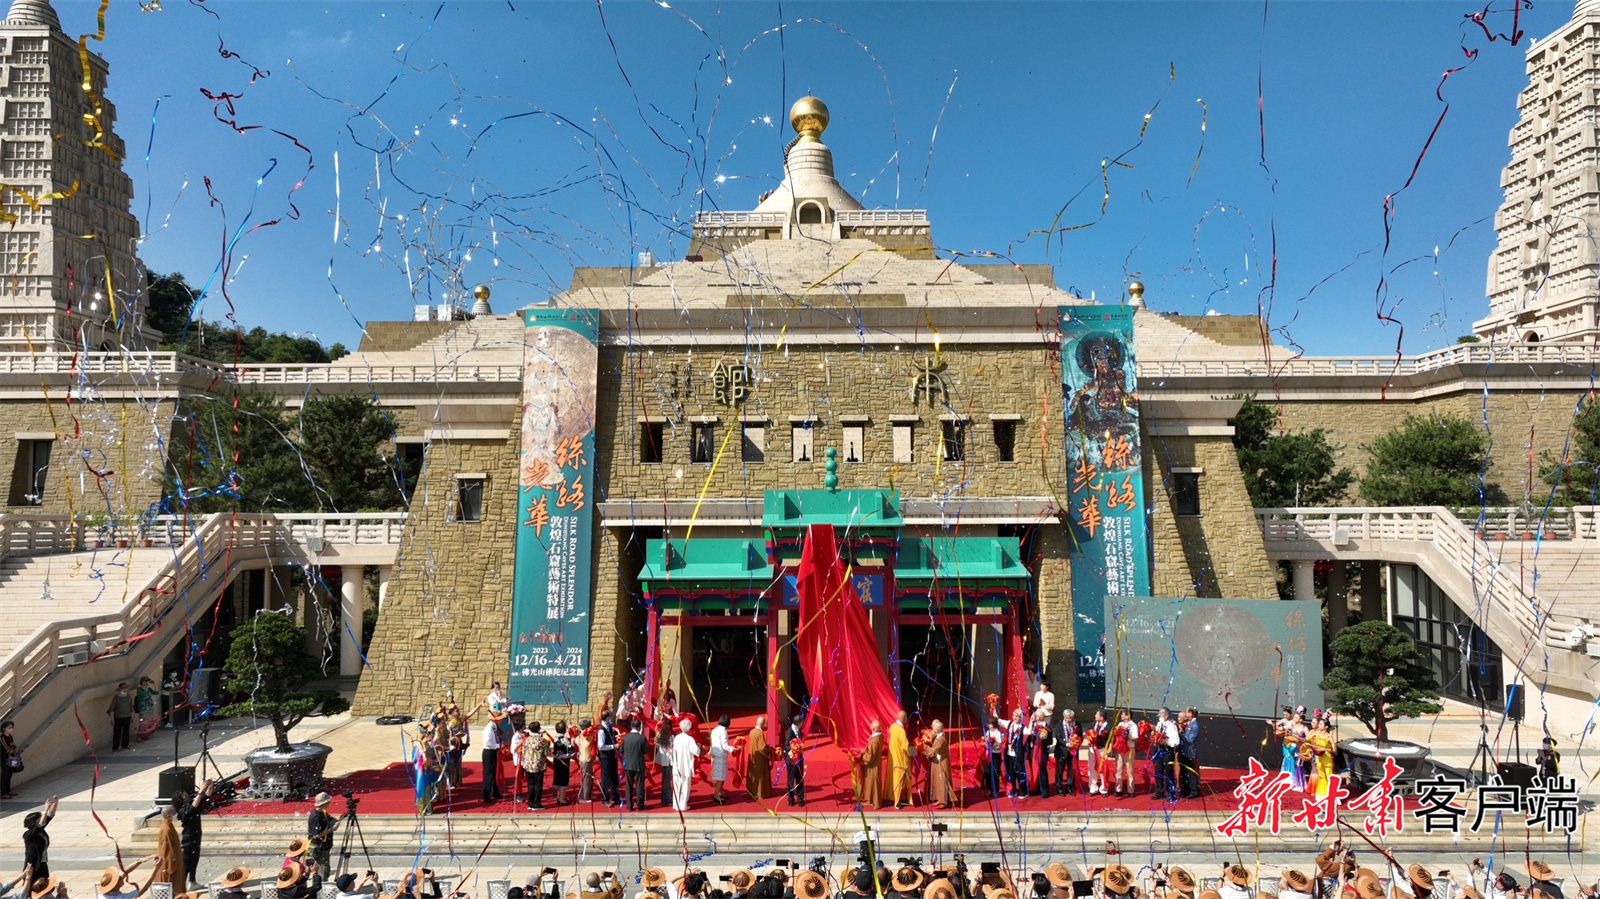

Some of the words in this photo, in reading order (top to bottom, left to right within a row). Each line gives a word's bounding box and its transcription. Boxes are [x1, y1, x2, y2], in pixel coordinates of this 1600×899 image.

[570, 516, 578, 536] SILK
[1123, 516, 1131, 536] SILK
[568, 537, 578, 563] ROAD
[1102, 516, 1119, 596] 敦煌石窟藝術
[1125, 538, 1133, 563] ROAD
[546, 515, 563, 620] 敦煌石窟藝術特展
[1126, 564, 1135, 597] SPLEND
[567, 564, 577, 611] SPLENDOR
